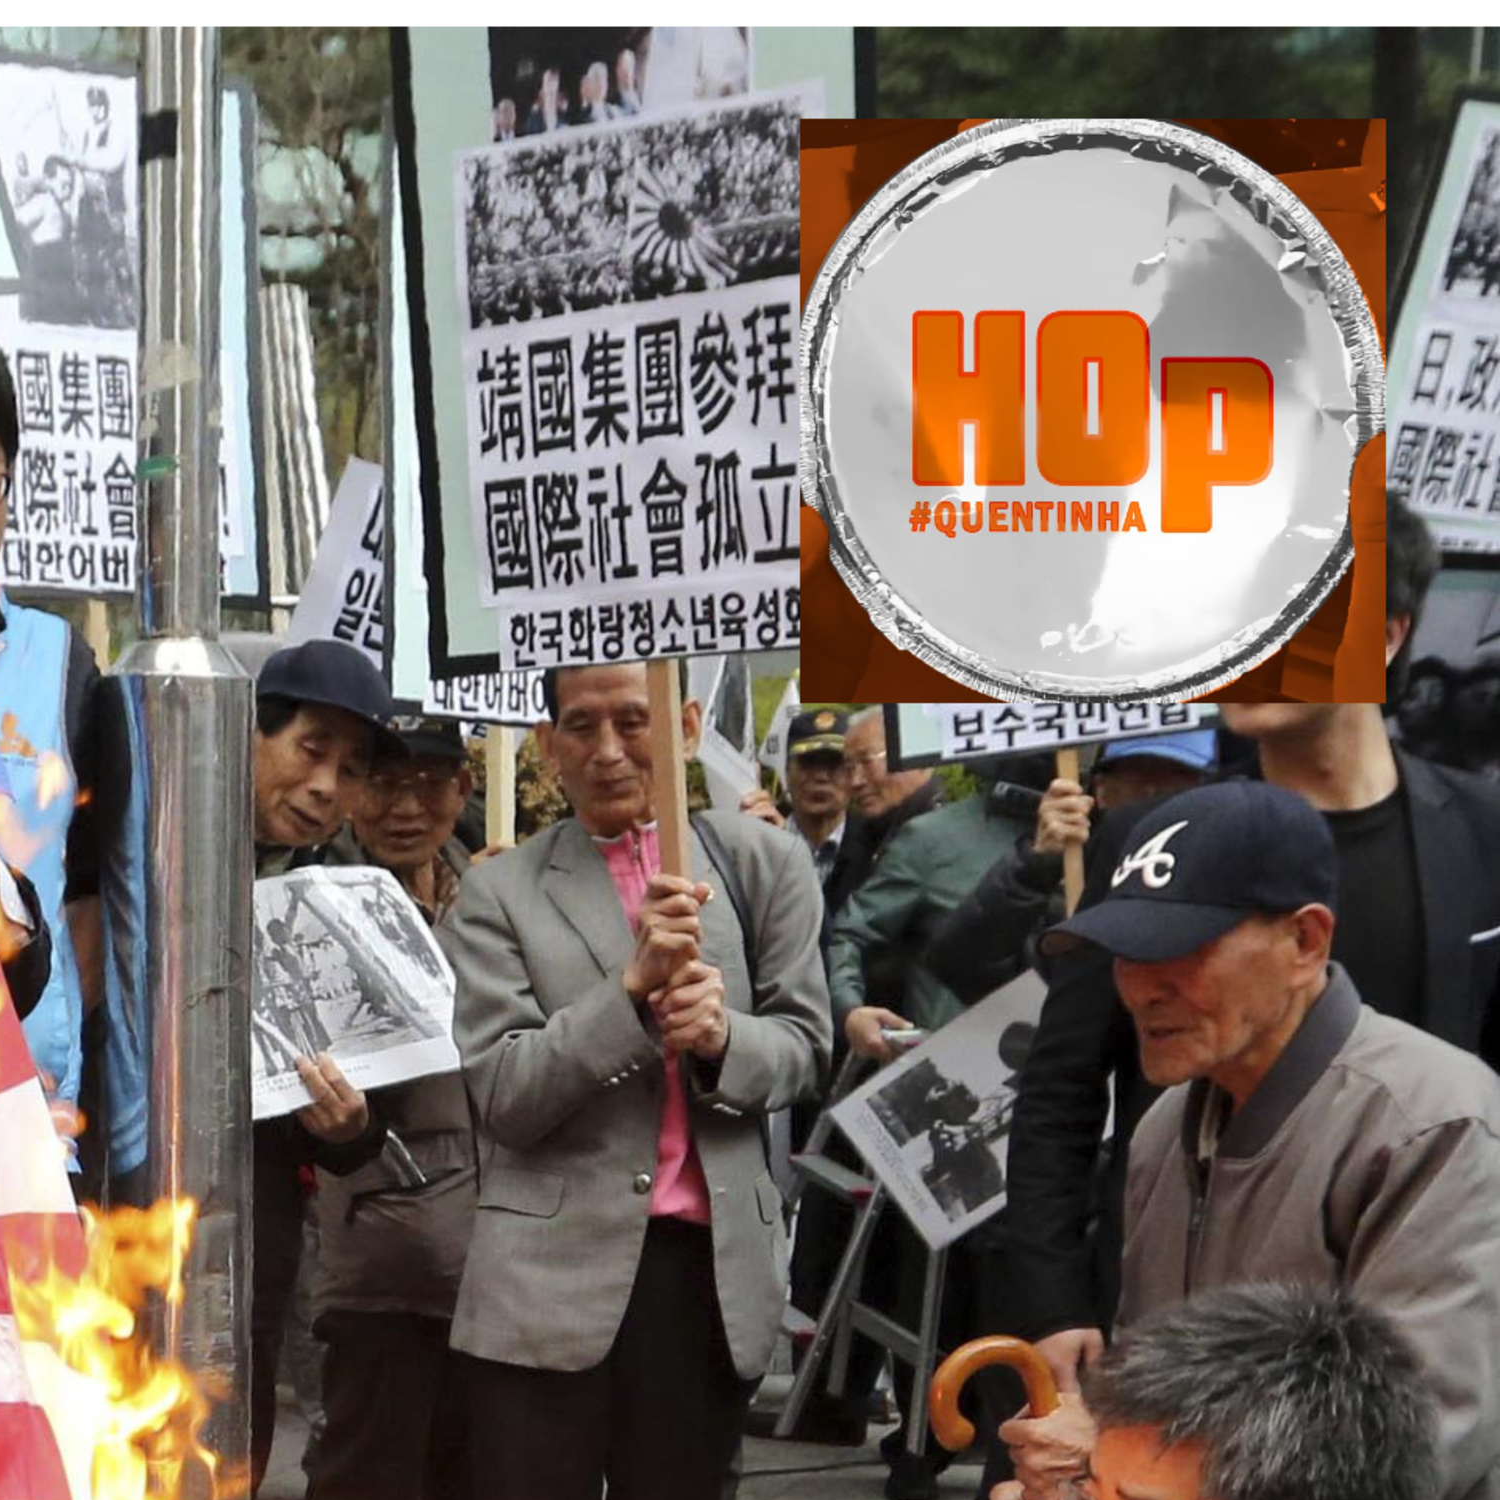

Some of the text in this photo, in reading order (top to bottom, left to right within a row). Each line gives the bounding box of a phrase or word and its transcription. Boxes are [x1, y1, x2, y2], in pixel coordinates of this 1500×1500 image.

[477, 303, 796, 462] 靖國集團參拜
[484, 442, 800, 595] 國際社會孤立
[1111, 820, 1189, 888] A
